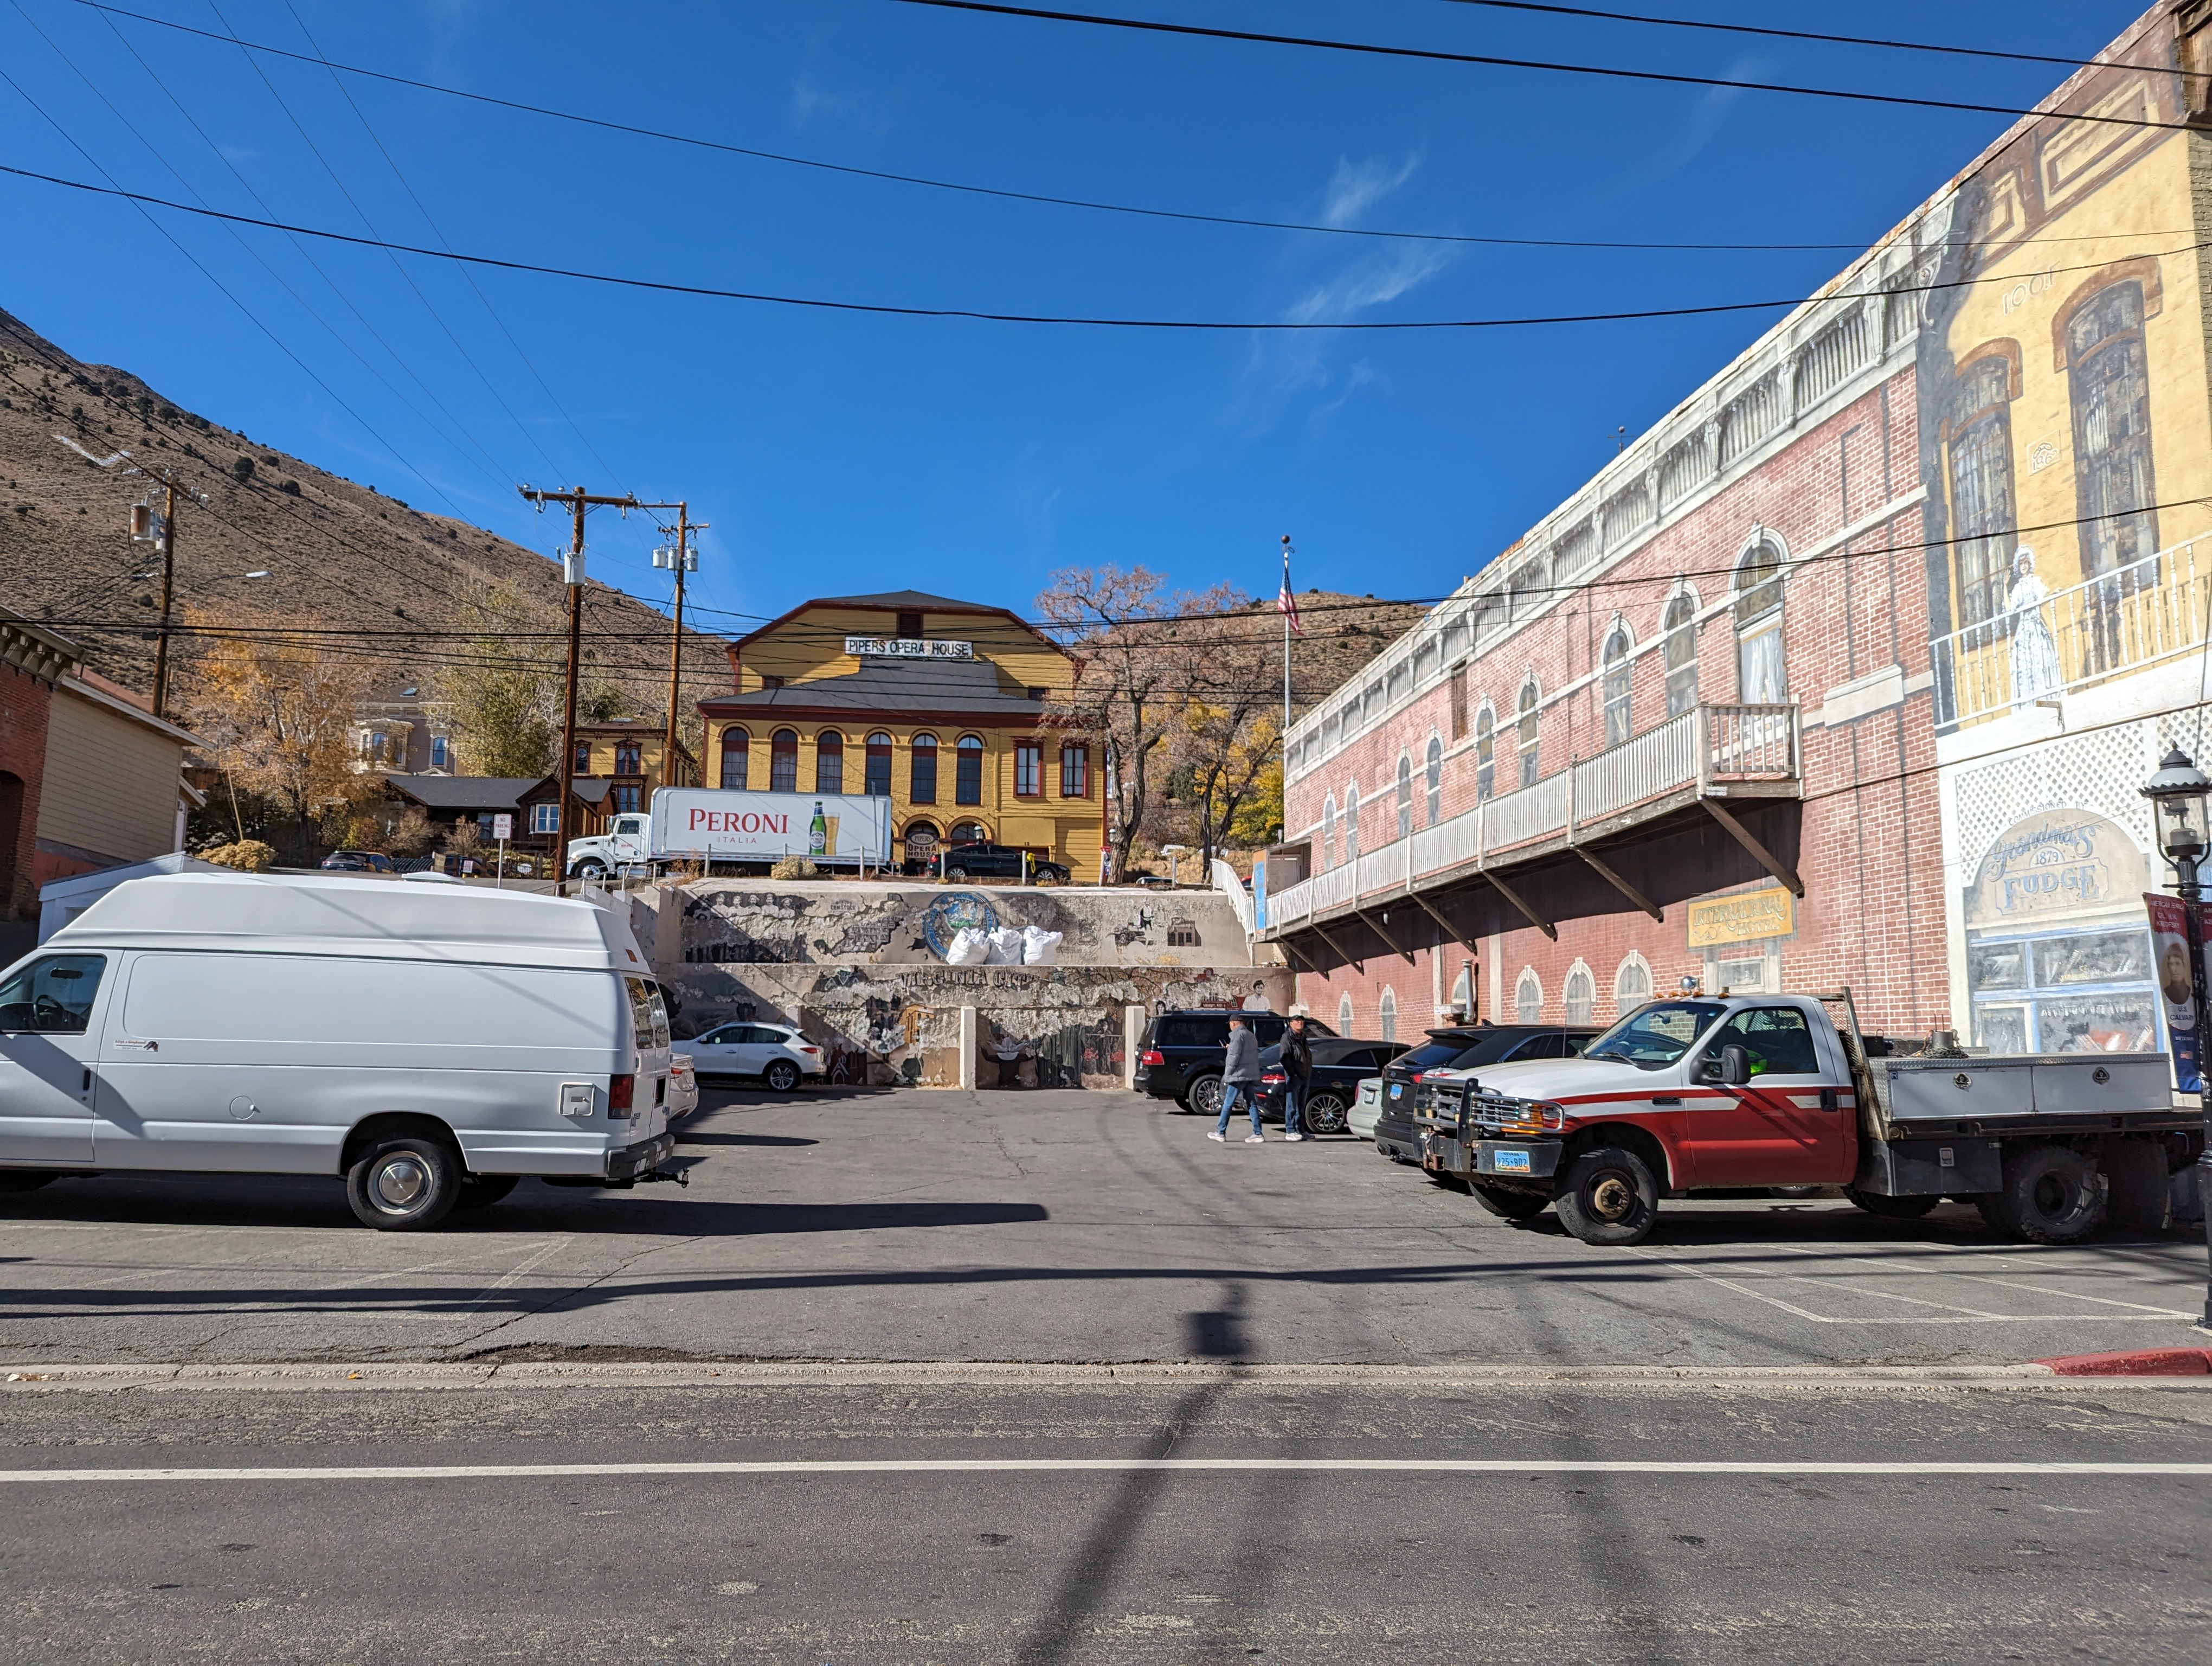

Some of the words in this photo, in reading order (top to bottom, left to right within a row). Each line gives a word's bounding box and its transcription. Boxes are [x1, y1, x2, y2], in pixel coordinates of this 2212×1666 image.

[890, 642, 924, 654] OPERA
[932, 643, 968, 656] HOUSE
[689, 808, 789, 834] PERONI
[2008, 801, 2067, 825] COMMISSIONED
[2075, 800, 2087, 810] BY
[2036, 851, 2059, 866] 1879
[2004, 865, 2100, 909] FUDGE
[1693, 894, 1787, 931] INTERNATIONAL
[1737, 918, 1780, 935] HOTEL
[896, 970, 989, 990] VIRGINIA
[1496, 1157, 1510, 1167] 925
